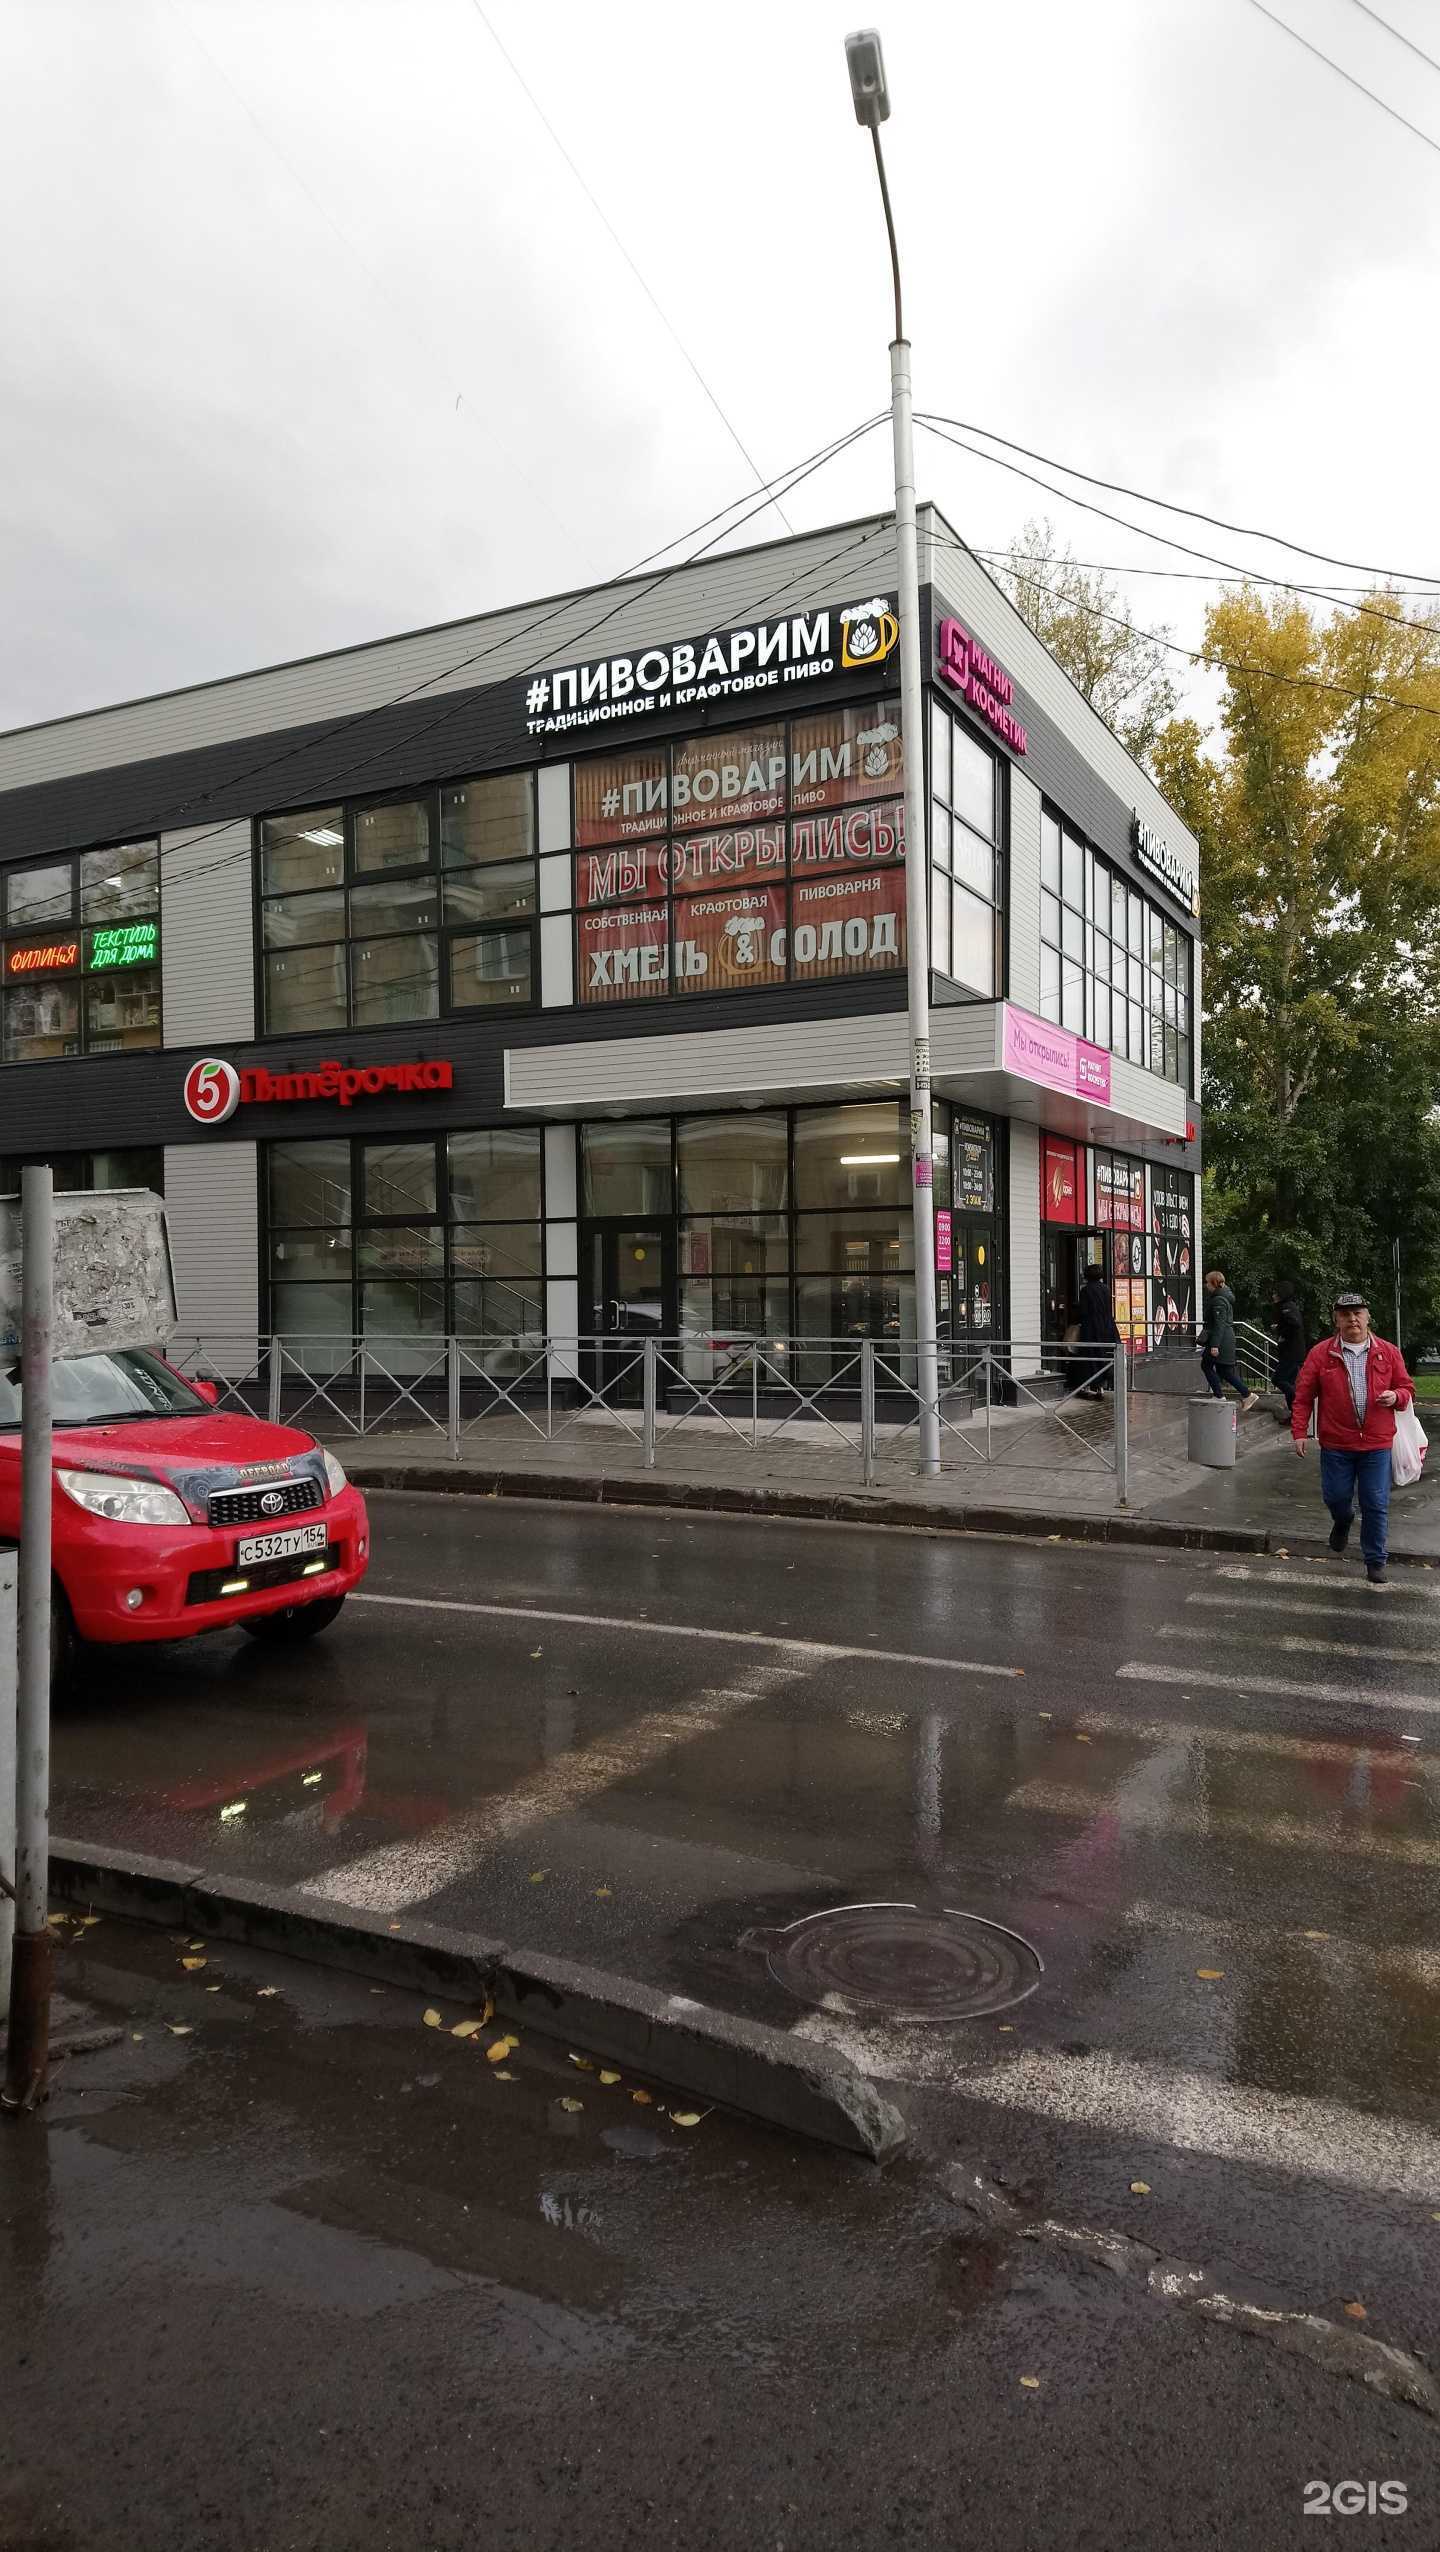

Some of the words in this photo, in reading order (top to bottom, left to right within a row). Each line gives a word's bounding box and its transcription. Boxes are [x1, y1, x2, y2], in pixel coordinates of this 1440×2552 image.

[526, 612, 830, 714] #ПИВОВАРИМ
[969, 640, 1014, 705] МАГНИТ
[526, 697, 655, 734] ТРАДИЦИОННОЕ
[659, 693, 672, 707] И
[675, 674, 779, 704] КРАФТОВОЕ
[783, 658, 834, 681] ПИВО
[965, 676, 1028, 755] КОСМЕТИК
[601, 743, 852, 817] #ПИВОВАРИМ
[621, 810, 706, 834] ТРАДИЦИОННОЕ
[709, 809, 718, 820] И
[720, 797, 784, 817] КРАФТОВОЕ
[793, 789, 826, 807] ПИВО
[587, 847, 647, 904] МЫ
[657, 804, 906, 883] ОТКРЫЛИСЬ!
[584, 908, 669, 931] СОБСТВЕННАЯ
[690, 895, 768, 917] КРАФТОВАЯ
[799, 877, 882, 902] ПИВОВАРНЯ
[91, 949, 118, 968] ДЛЯ
[119, 944, 154, 965] ДОМА
[92, 923, 156, 949] ТЕКСТИЛЬ
[588, 939, 708, 988] ХМЕЛЬ
[735, 933, 754, 965] &
[770, 912, 899, 967] СОЛОД
[1013, 1030, 1027, 1051] Мы
[1028, 1039, 1070, 1069] открылись!
[197, 1063, 221, 1111] 5
[240, 1061, 453, 1106] Пятёрочка
[1169, 1174, 1173, 1188] С
[244, 1535, 301, 1561] С532ТУ
[304, 1526, 325, 1543] 154
